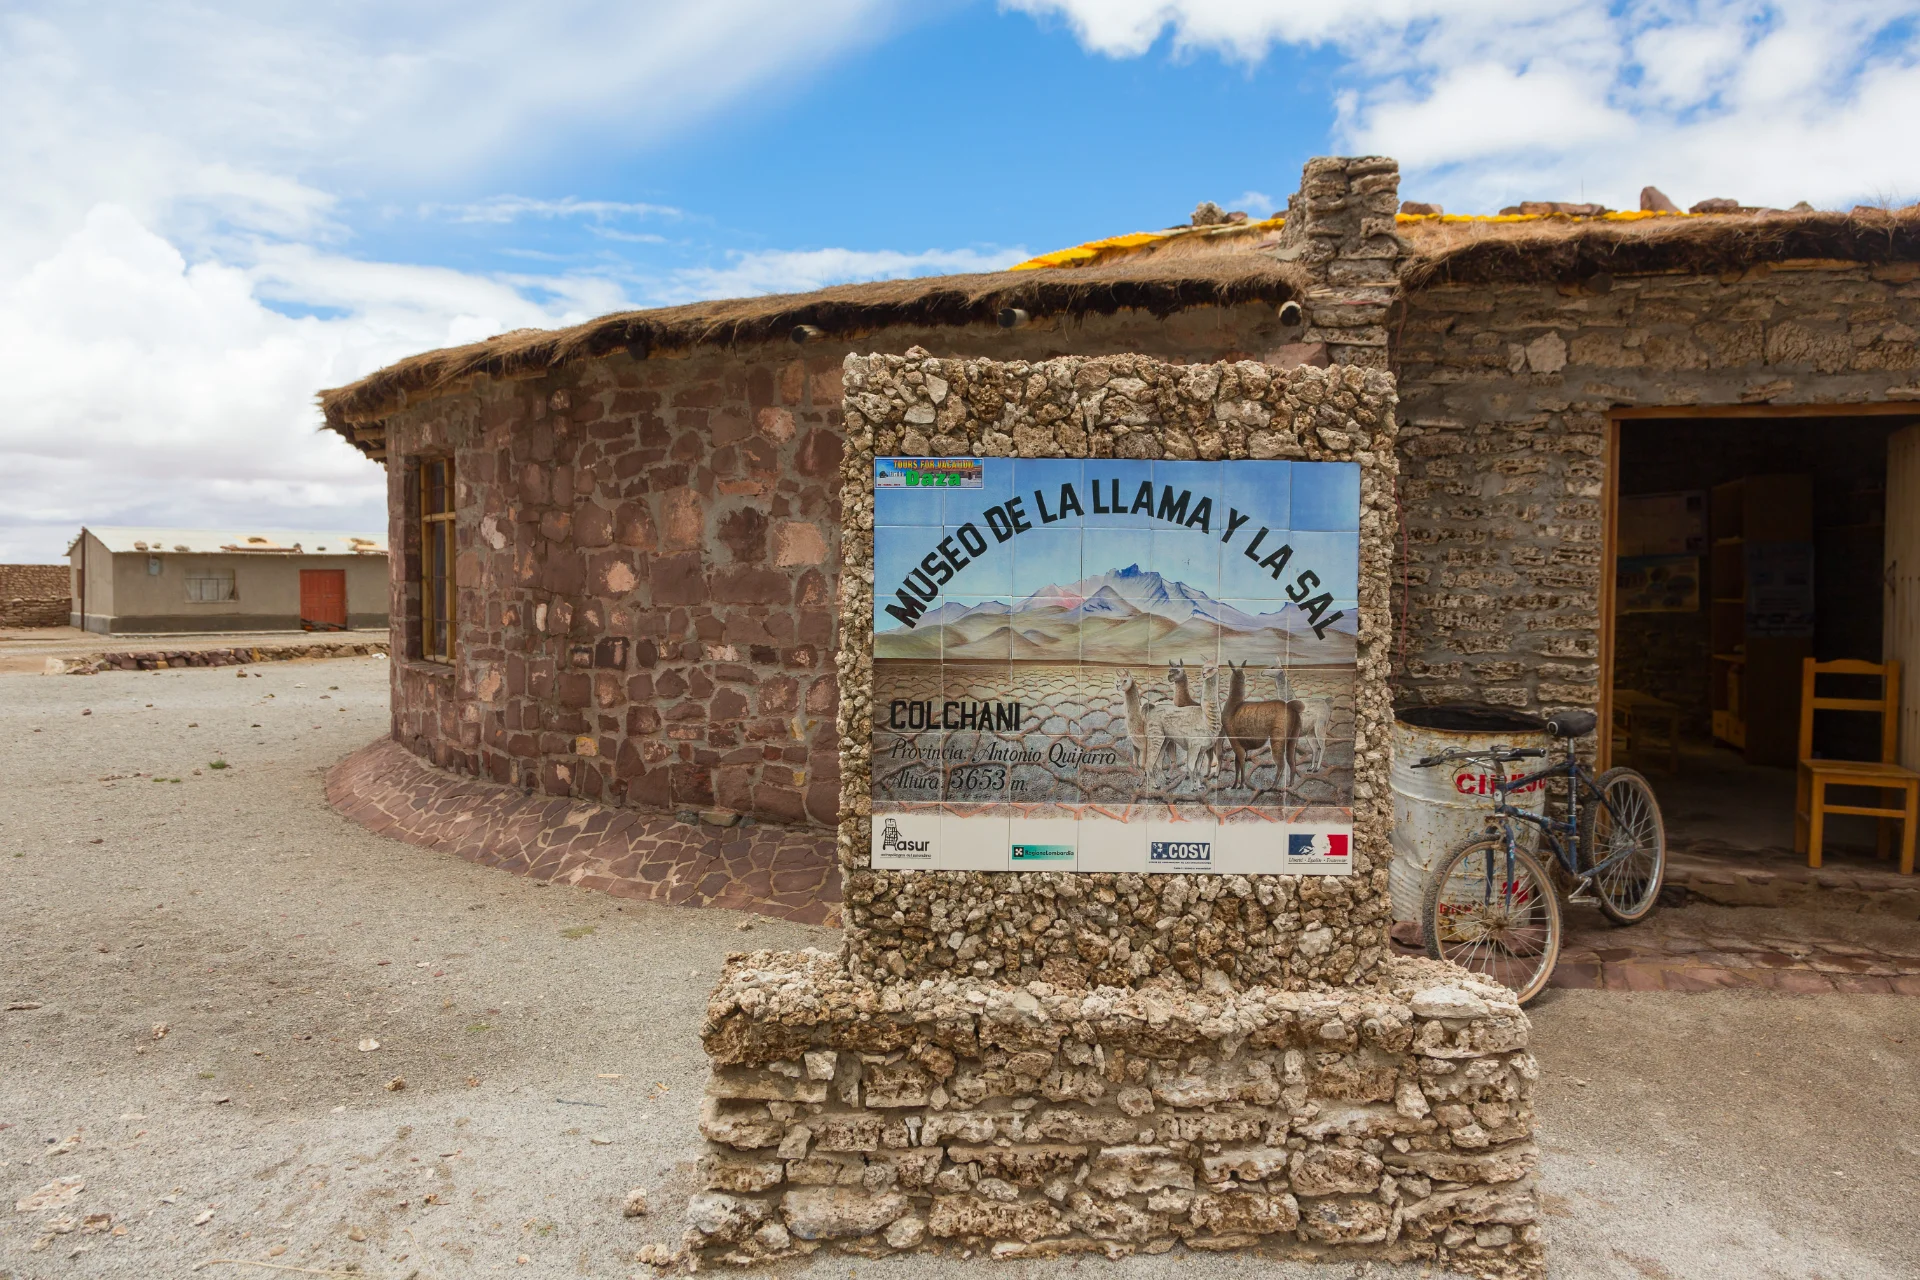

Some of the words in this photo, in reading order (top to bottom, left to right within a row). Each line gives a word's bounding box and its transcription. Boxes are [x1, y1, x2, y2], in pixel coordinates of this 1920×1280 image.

[893, 459, 918, 469] TOURS
[920, 459, 935, 469] FOR
[905, 470, 961, 486] Daza
[884, 522, 988, 629] MUSEO
[983, 496, 1032, 543] DE
[1034, 483, 1085, 524] LA
[1092, 478, 1212, 534] LLAMA
[1221, 507, 1250, 544] Y
[1244, 526, 1294, 580] LA
[1285, 569, 1344, 641] SAL
[890, 700, 1022, 731] COLCHANI
[972, 742, 1042, 763] Antonio
[1048, 743, 1116, 769] Quijarro
[951, 768, 1006, 790] 3653
[1168, 843, 1210, 859] COSV
